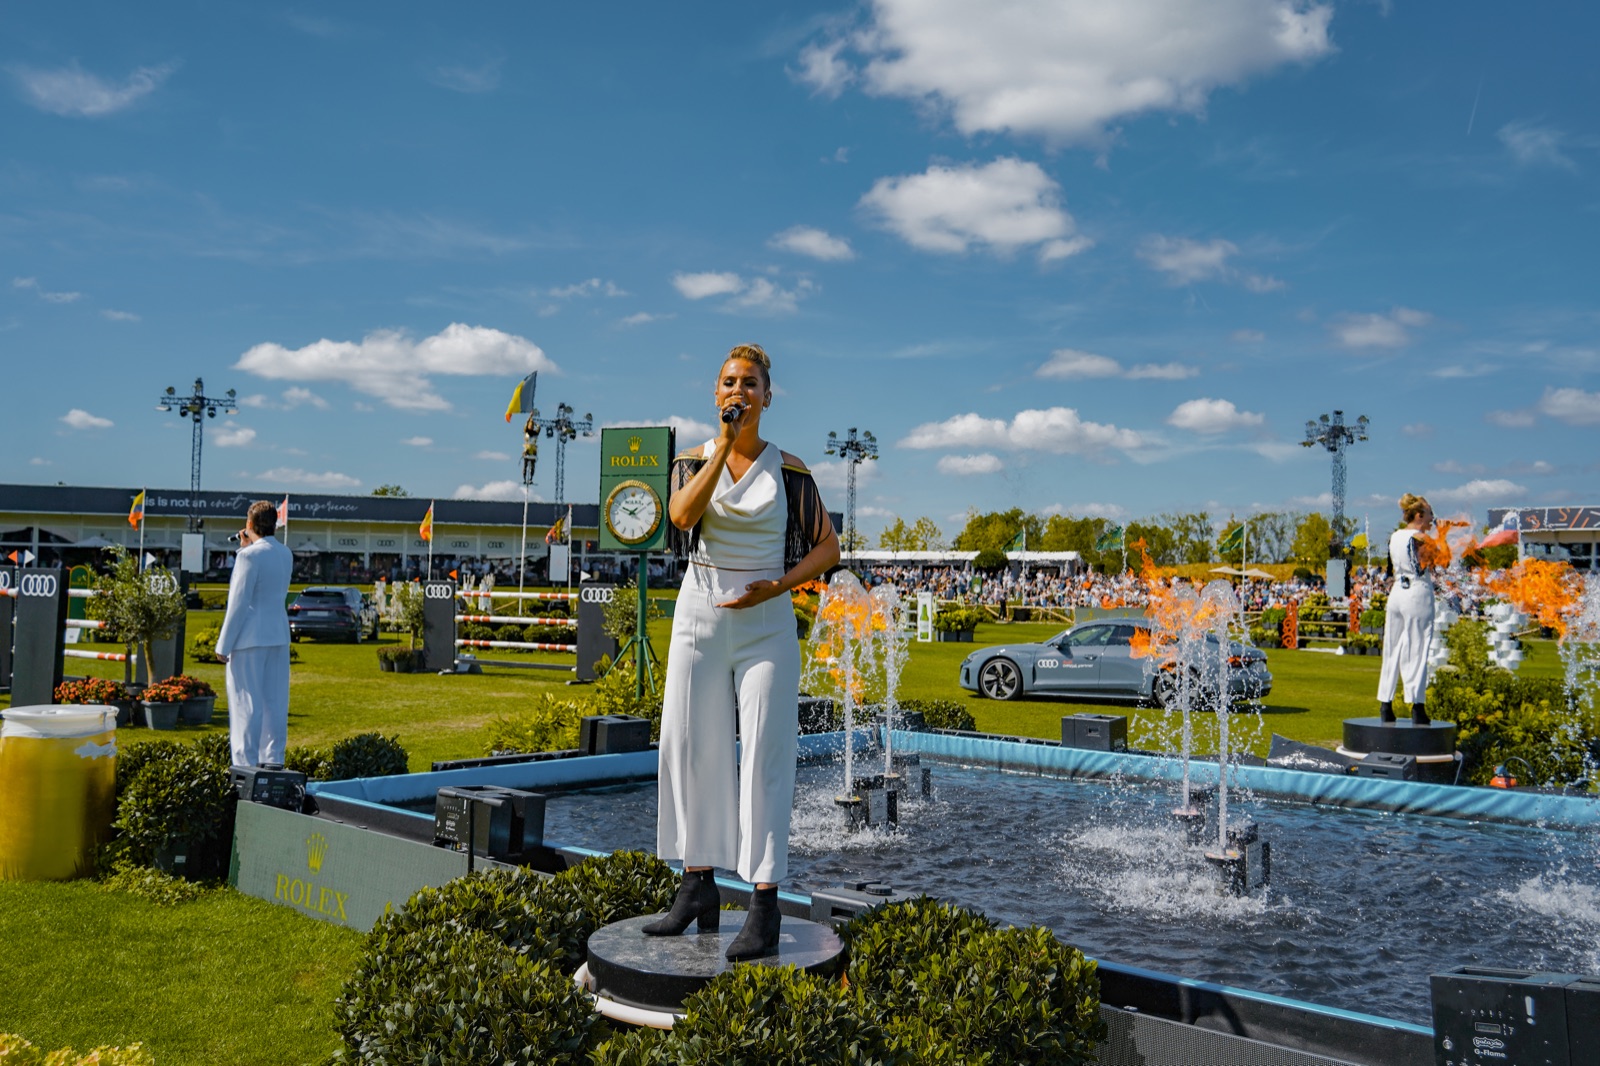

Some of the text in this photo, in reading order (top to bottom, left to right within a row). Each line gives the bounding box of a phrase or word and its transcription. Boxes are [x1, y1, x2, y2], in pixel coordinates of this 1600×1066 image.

[611, 455, 659, 467] ROLEX
[157, 496, 168, 507] is
[170, 497, 190, 508] not
[192, 498, 207, 508] an
[210, 494, 247, 510] event
[288, 502, 301, 511] an
[304, 500, 358, 516] experience
[275, 873, 349, 922] ROLEX
[1474, 1049, 1506, 1057] G-Flame
